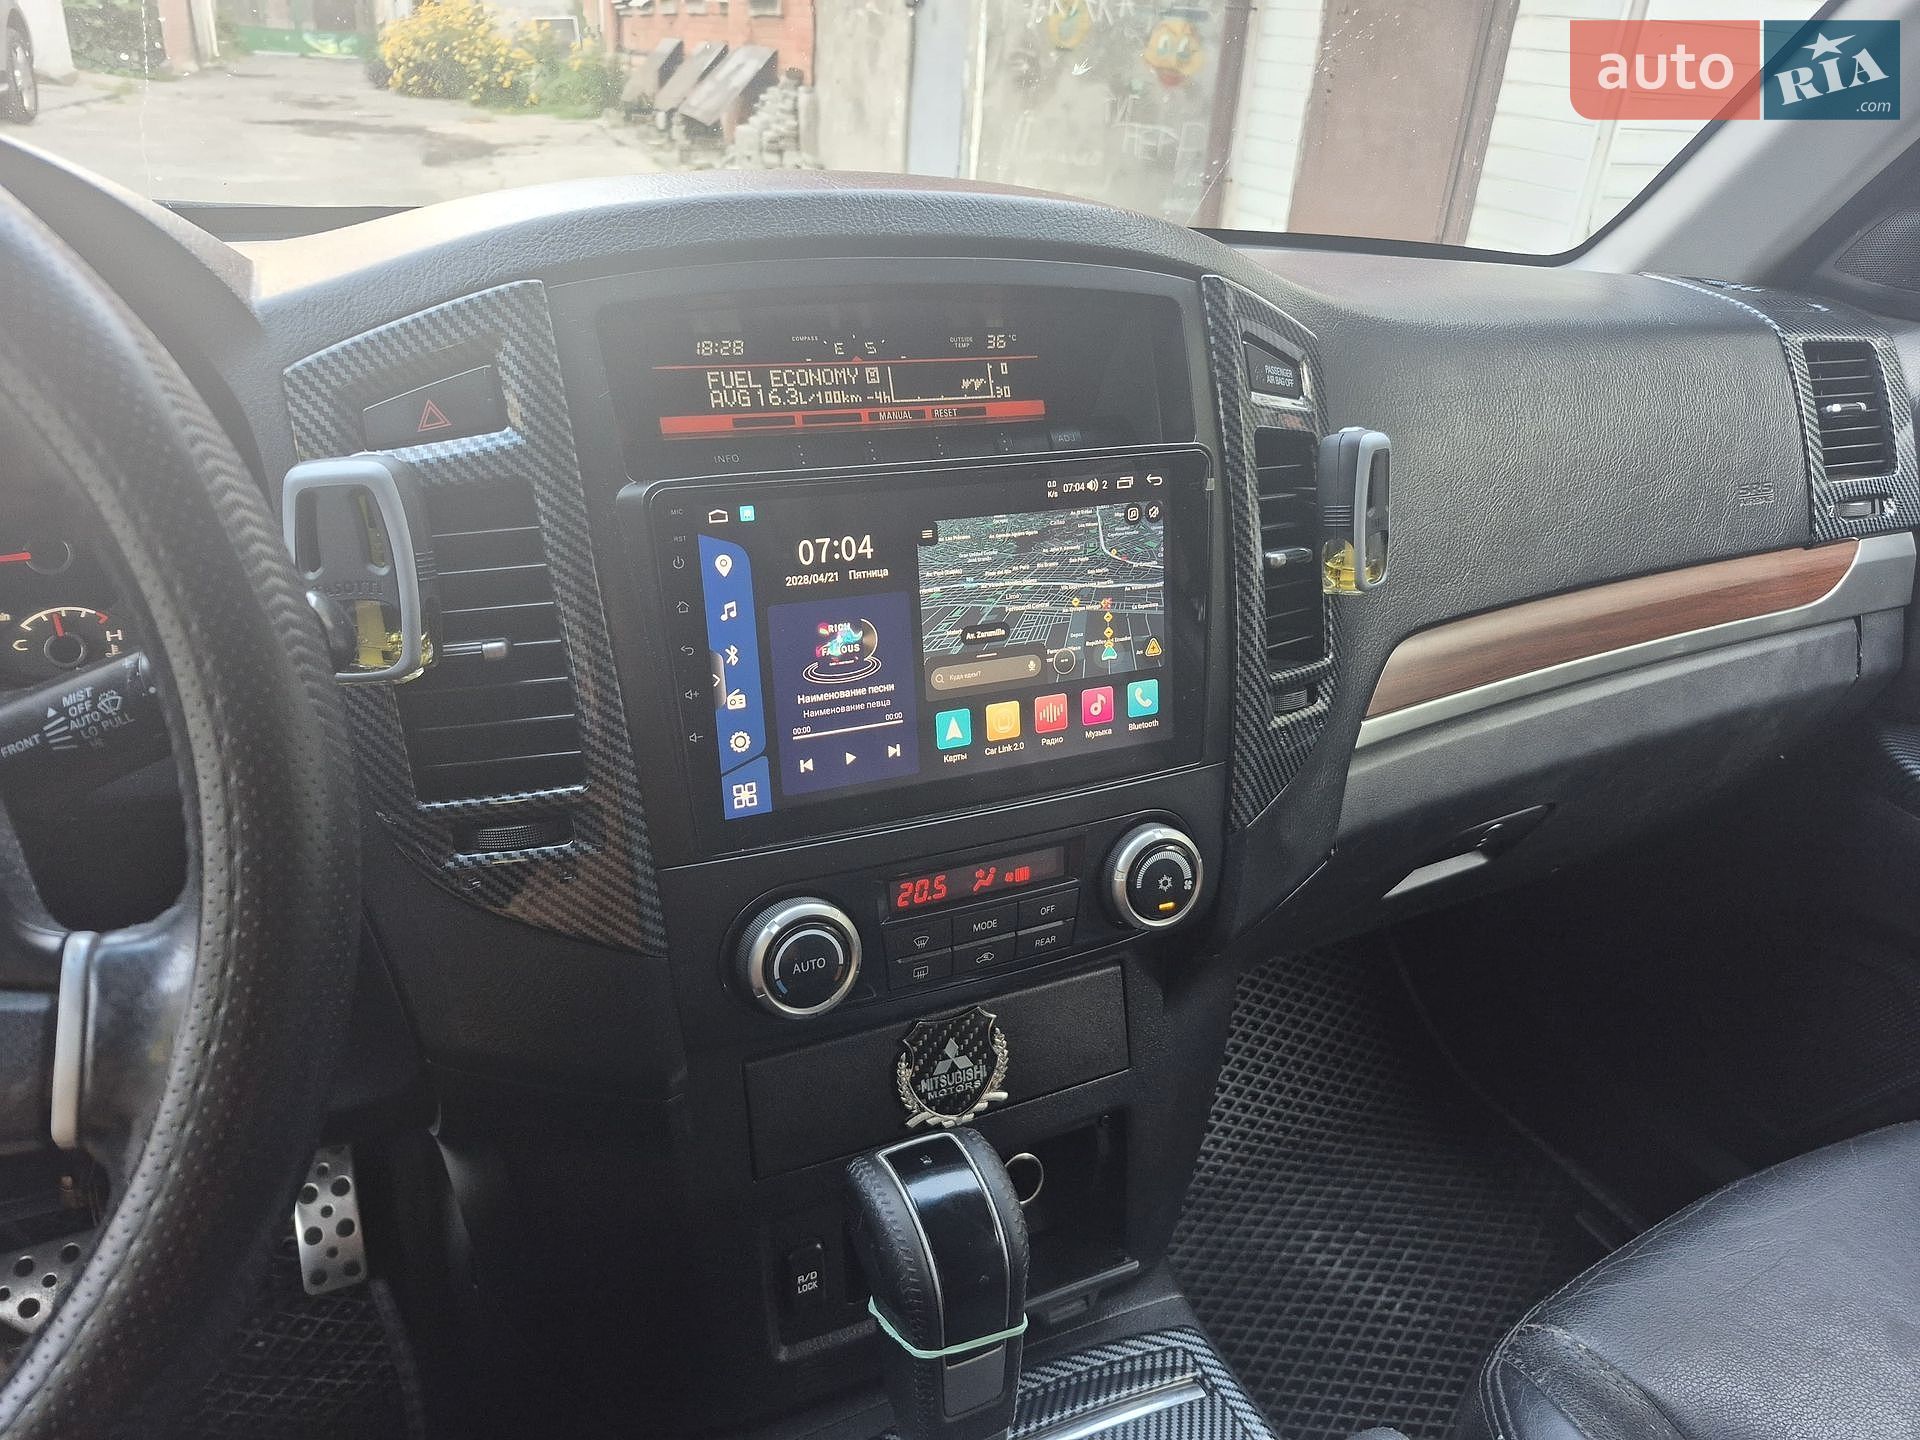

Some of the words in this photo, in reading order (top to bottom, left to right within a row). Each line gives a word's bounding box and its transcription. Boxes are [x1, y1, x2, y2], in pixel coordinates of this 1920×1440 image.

[697, 339, 744, 356] 18:28
[986, 334, 1006, 349] 36
[707, 370, 762, 390] FUEL
[769, 367, 859, 388] ECONOMY
[710, 388, 751, 408] AVG
[878, 408, 913, 421] MANUAL
[933, 408, 958, 418] RESET
[713, 454, 740, 464] INFO
[1063, 482, 1086, 493] 07:04
[1102, 480, 1108, 489] 2
[797, 534, 875, 566] 07:04
[784, 571, 840, 587] 2028/04/21
[848, 566, 889, 581] Пятница
[821, 643, 861, 656] FAOUS
[62, 686, 95, 708] MIST
[797, 685, 867, 705] Наименование
[867, 683, 895, 695] песни
[68, 699, 93, 717] OFF
[803, 701, 866, 719] Наименование
[866, 699, 891, 710] певца
[70, 710, 101, 731] AUTO
[100, 711, 136, 730] PULL
[885, 711, 904, 721] 00:00
[792, 725, 812, 736] 00:00
[1128, 718, 1159, 731] Bluetooth
[1085, 727, 1113, 739] Музыка
[0, 733, 41, 758] FRONT
[984, 746, 998, 756] Car
[997, 743, 1012, 754] Link
[1012, 741, 1025, 751] 2.0
[1041, 736, 1064, 747] Радио
[943, 752, 968, 764] Карты
[897, 874, 947, 907] 20.5
[1039, 904, 1056, 916] OFF
[972, 918, 998, 932] MODE
[1034, 934, 1057, 947] REAR
[792, 956, 827, 976] AUTO
[920, 1064, 988, 1093] MITSUBISHI
[927, 1079, 982, 1101] MOTORS
[797, 1280, 819, 1294] LOCK
